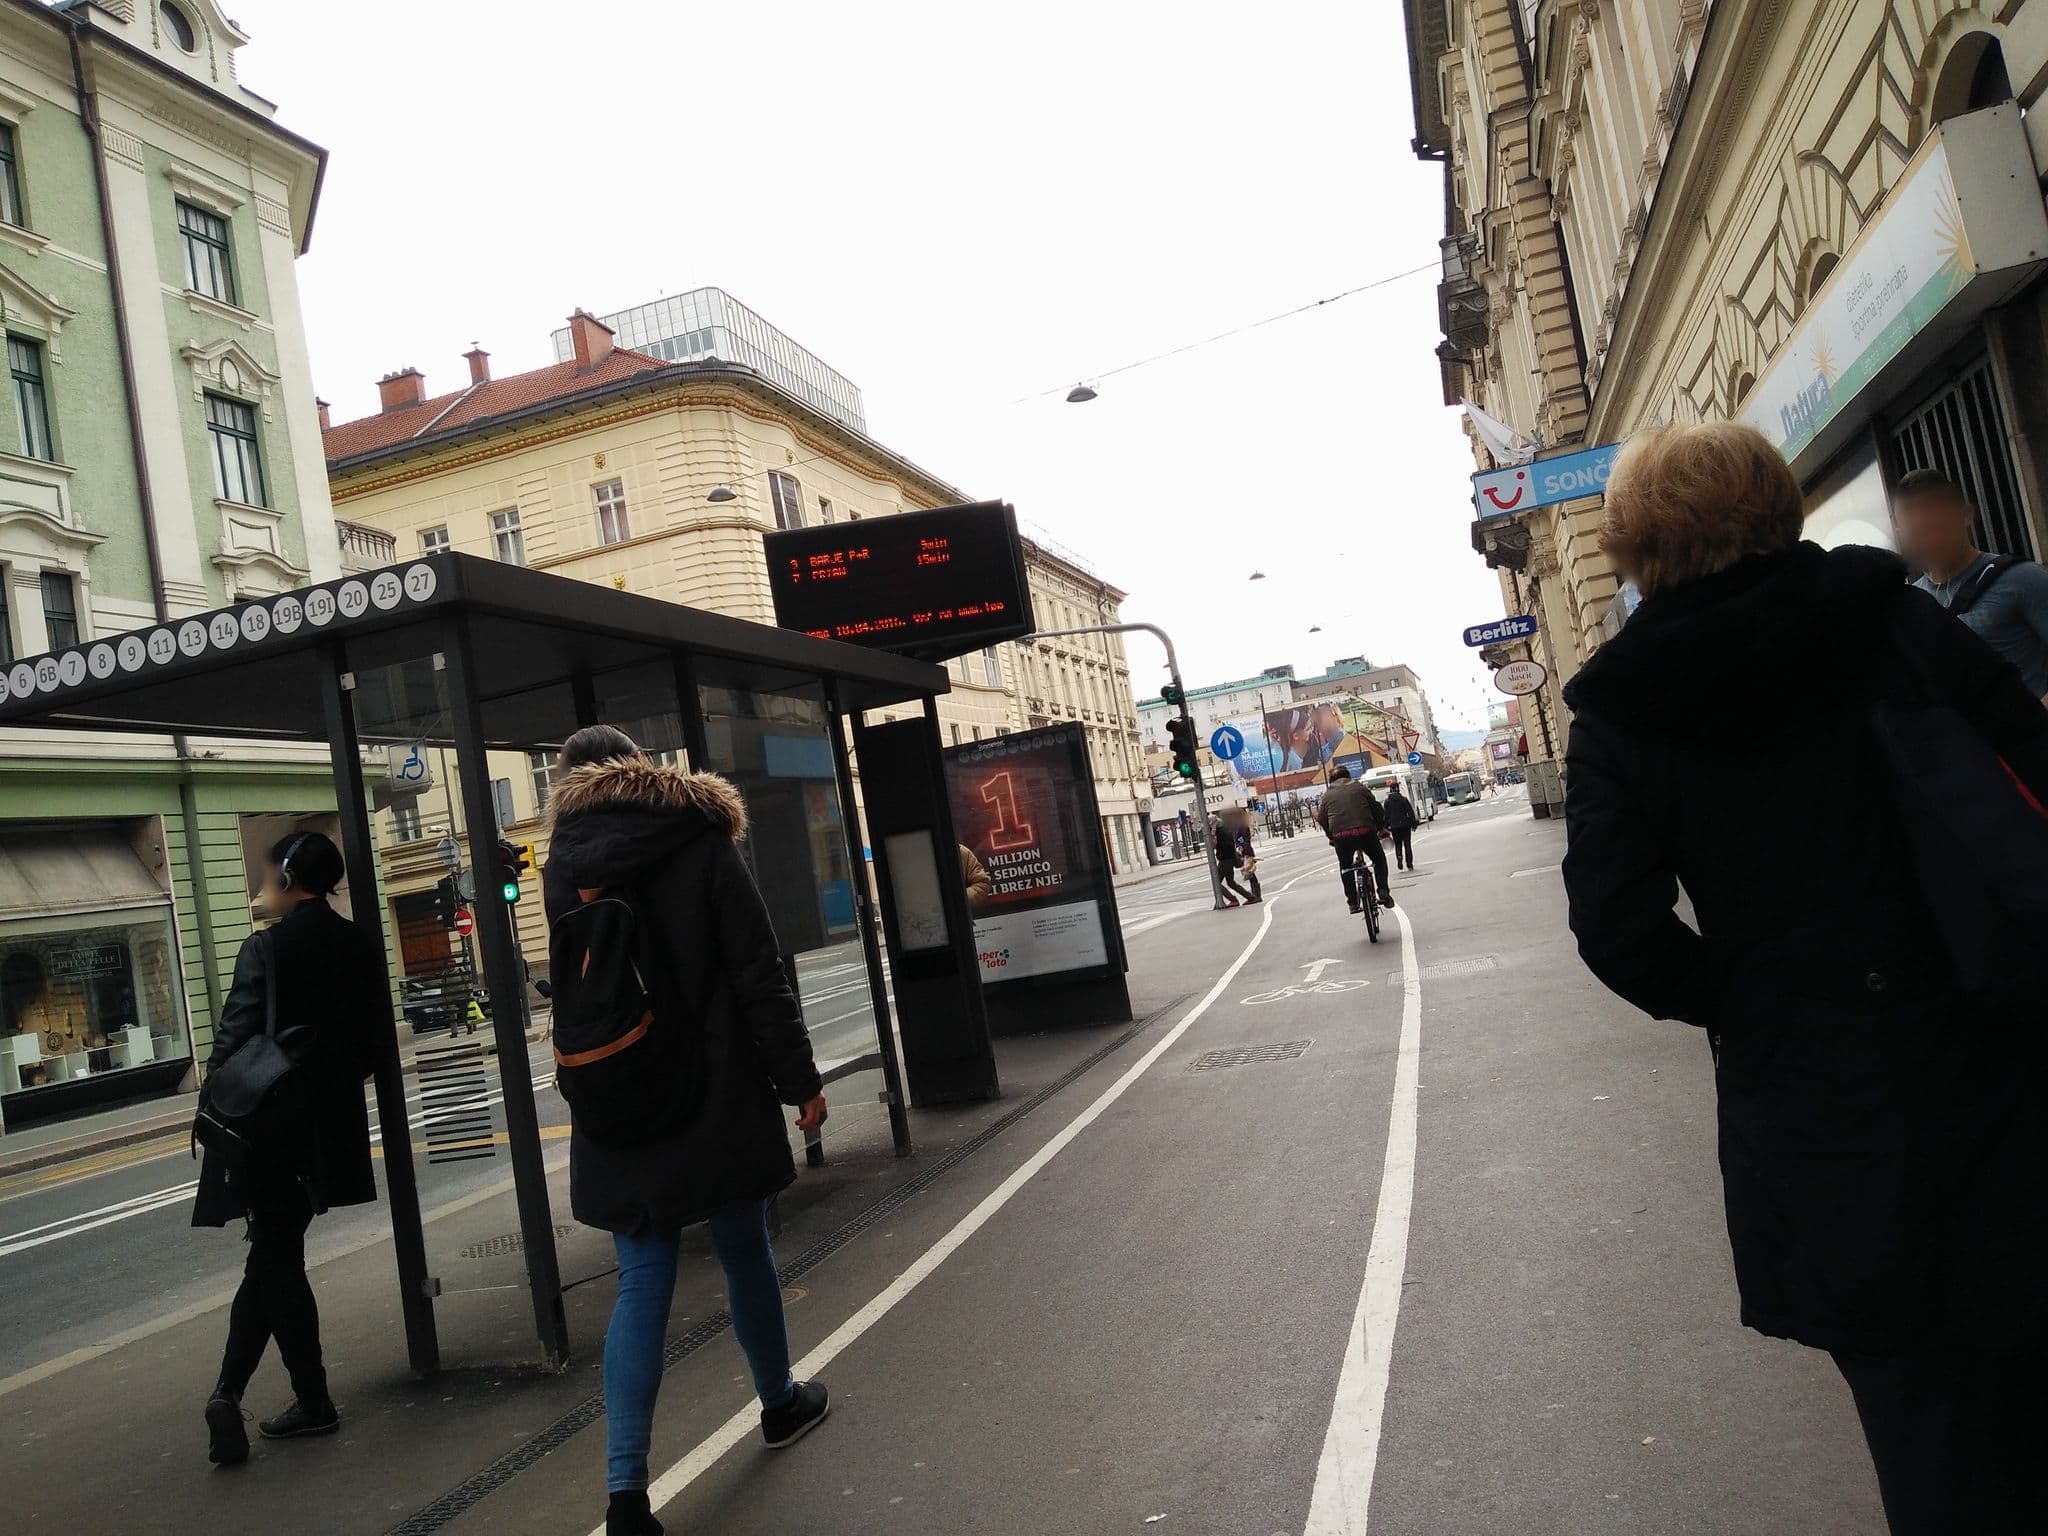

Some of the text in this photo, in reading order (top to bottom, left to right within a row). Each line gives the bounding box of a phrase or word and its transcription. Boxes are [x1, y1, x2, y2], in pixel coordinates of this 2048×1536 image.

[1543, 458, 1612, 496] SONČ
[809, 552, 844, 567] BARJE
[18, 672, 27, 689] 6
[39, 665, 57, 683] 6B
[68, 660, 76, 677] 7
[98, 653, 107, 669] 8
[127, 646, 137, 662] 9
[153, 638, 172, 656] 11
[184, 629, 202, 648] 13
[215, 622, 234, 641] 14
[246, 614, 265, 633] 18
[273, 605, 302, 626] 19B
[344, 589, 363, 609] 20
[377, 580, 397, 601] 25
[411, 572, 430, 593] 27
[1469, 620, 1530, 643] Berlitz
[980, 771, 1034, 850] 1
[988, 848, 1041, 868] MILIJON
[995, 861, 1051, 881] SEDMICO
[1001, 878, 1033, 895] BREZ
[1035, 872, 1063, 888] NJE!
[976, 949, 999, 963] uper
[987, 958, 1007, 969] loto
